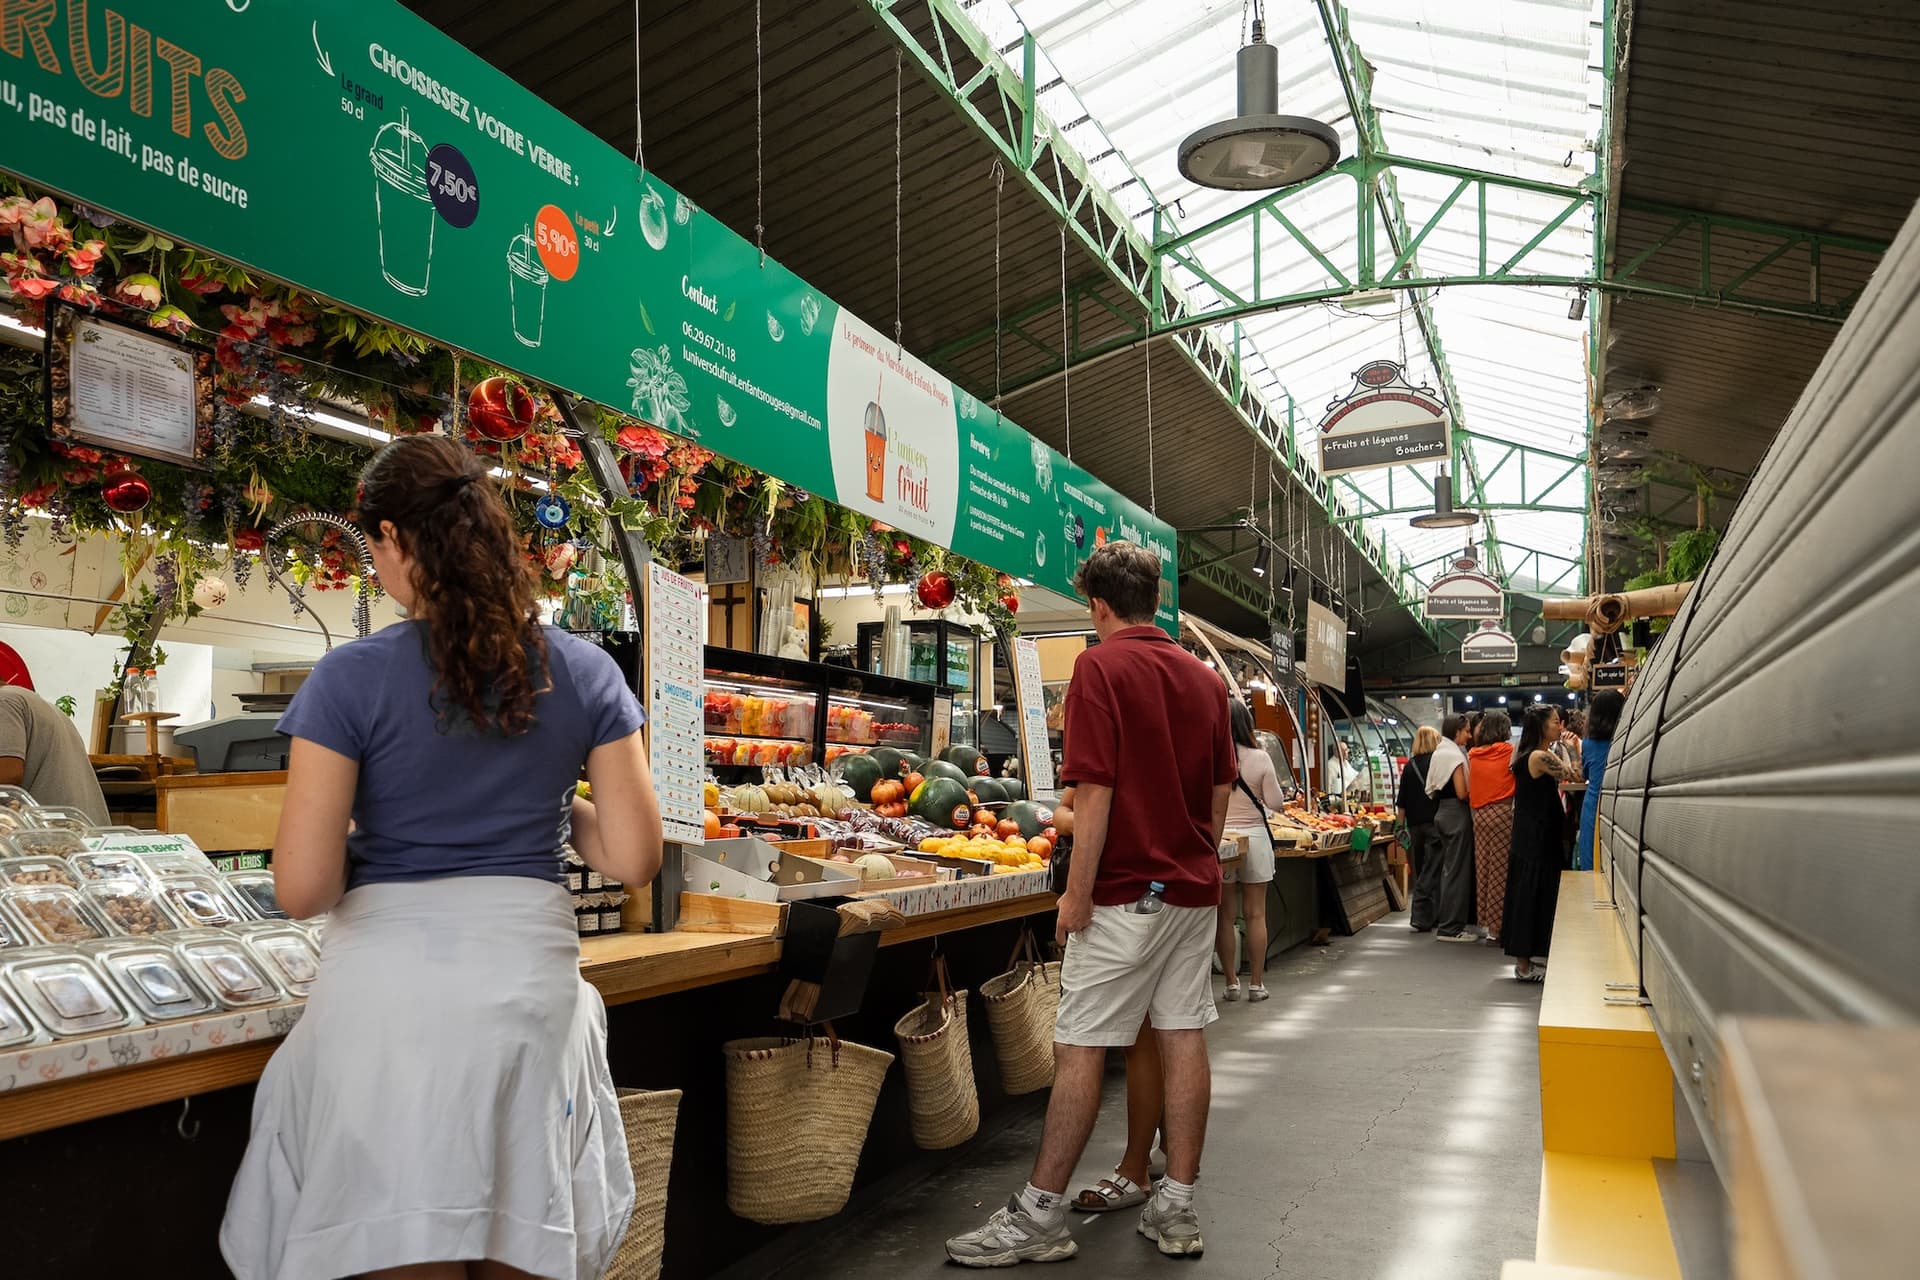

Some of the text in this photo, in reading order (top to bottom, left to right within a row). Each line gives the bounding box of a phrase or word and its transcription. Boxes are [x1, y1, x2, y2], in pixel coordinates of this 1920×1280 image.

[340, 96, 364, 121] 50 cl
[341, 72, 384, 111] Le grand
[368, 42, 470, 123] CHOISISSEZ
[474, 105, 524, 156] VOTRE
[527, 138, 572, 186] VERRE
[0, 79, 248, 209] u, pas de lait, pas de sucre
[429, 160, 477, 204] 7,50€
[537, 221, 577, 257] 5,90€
[681, 274, 719, 316] Contact
[1332, 433, 1409, 451] Fruits et légumes
[1395, 441, 1434, 456] Boucher
[897, 464, 930, 513] fruit
